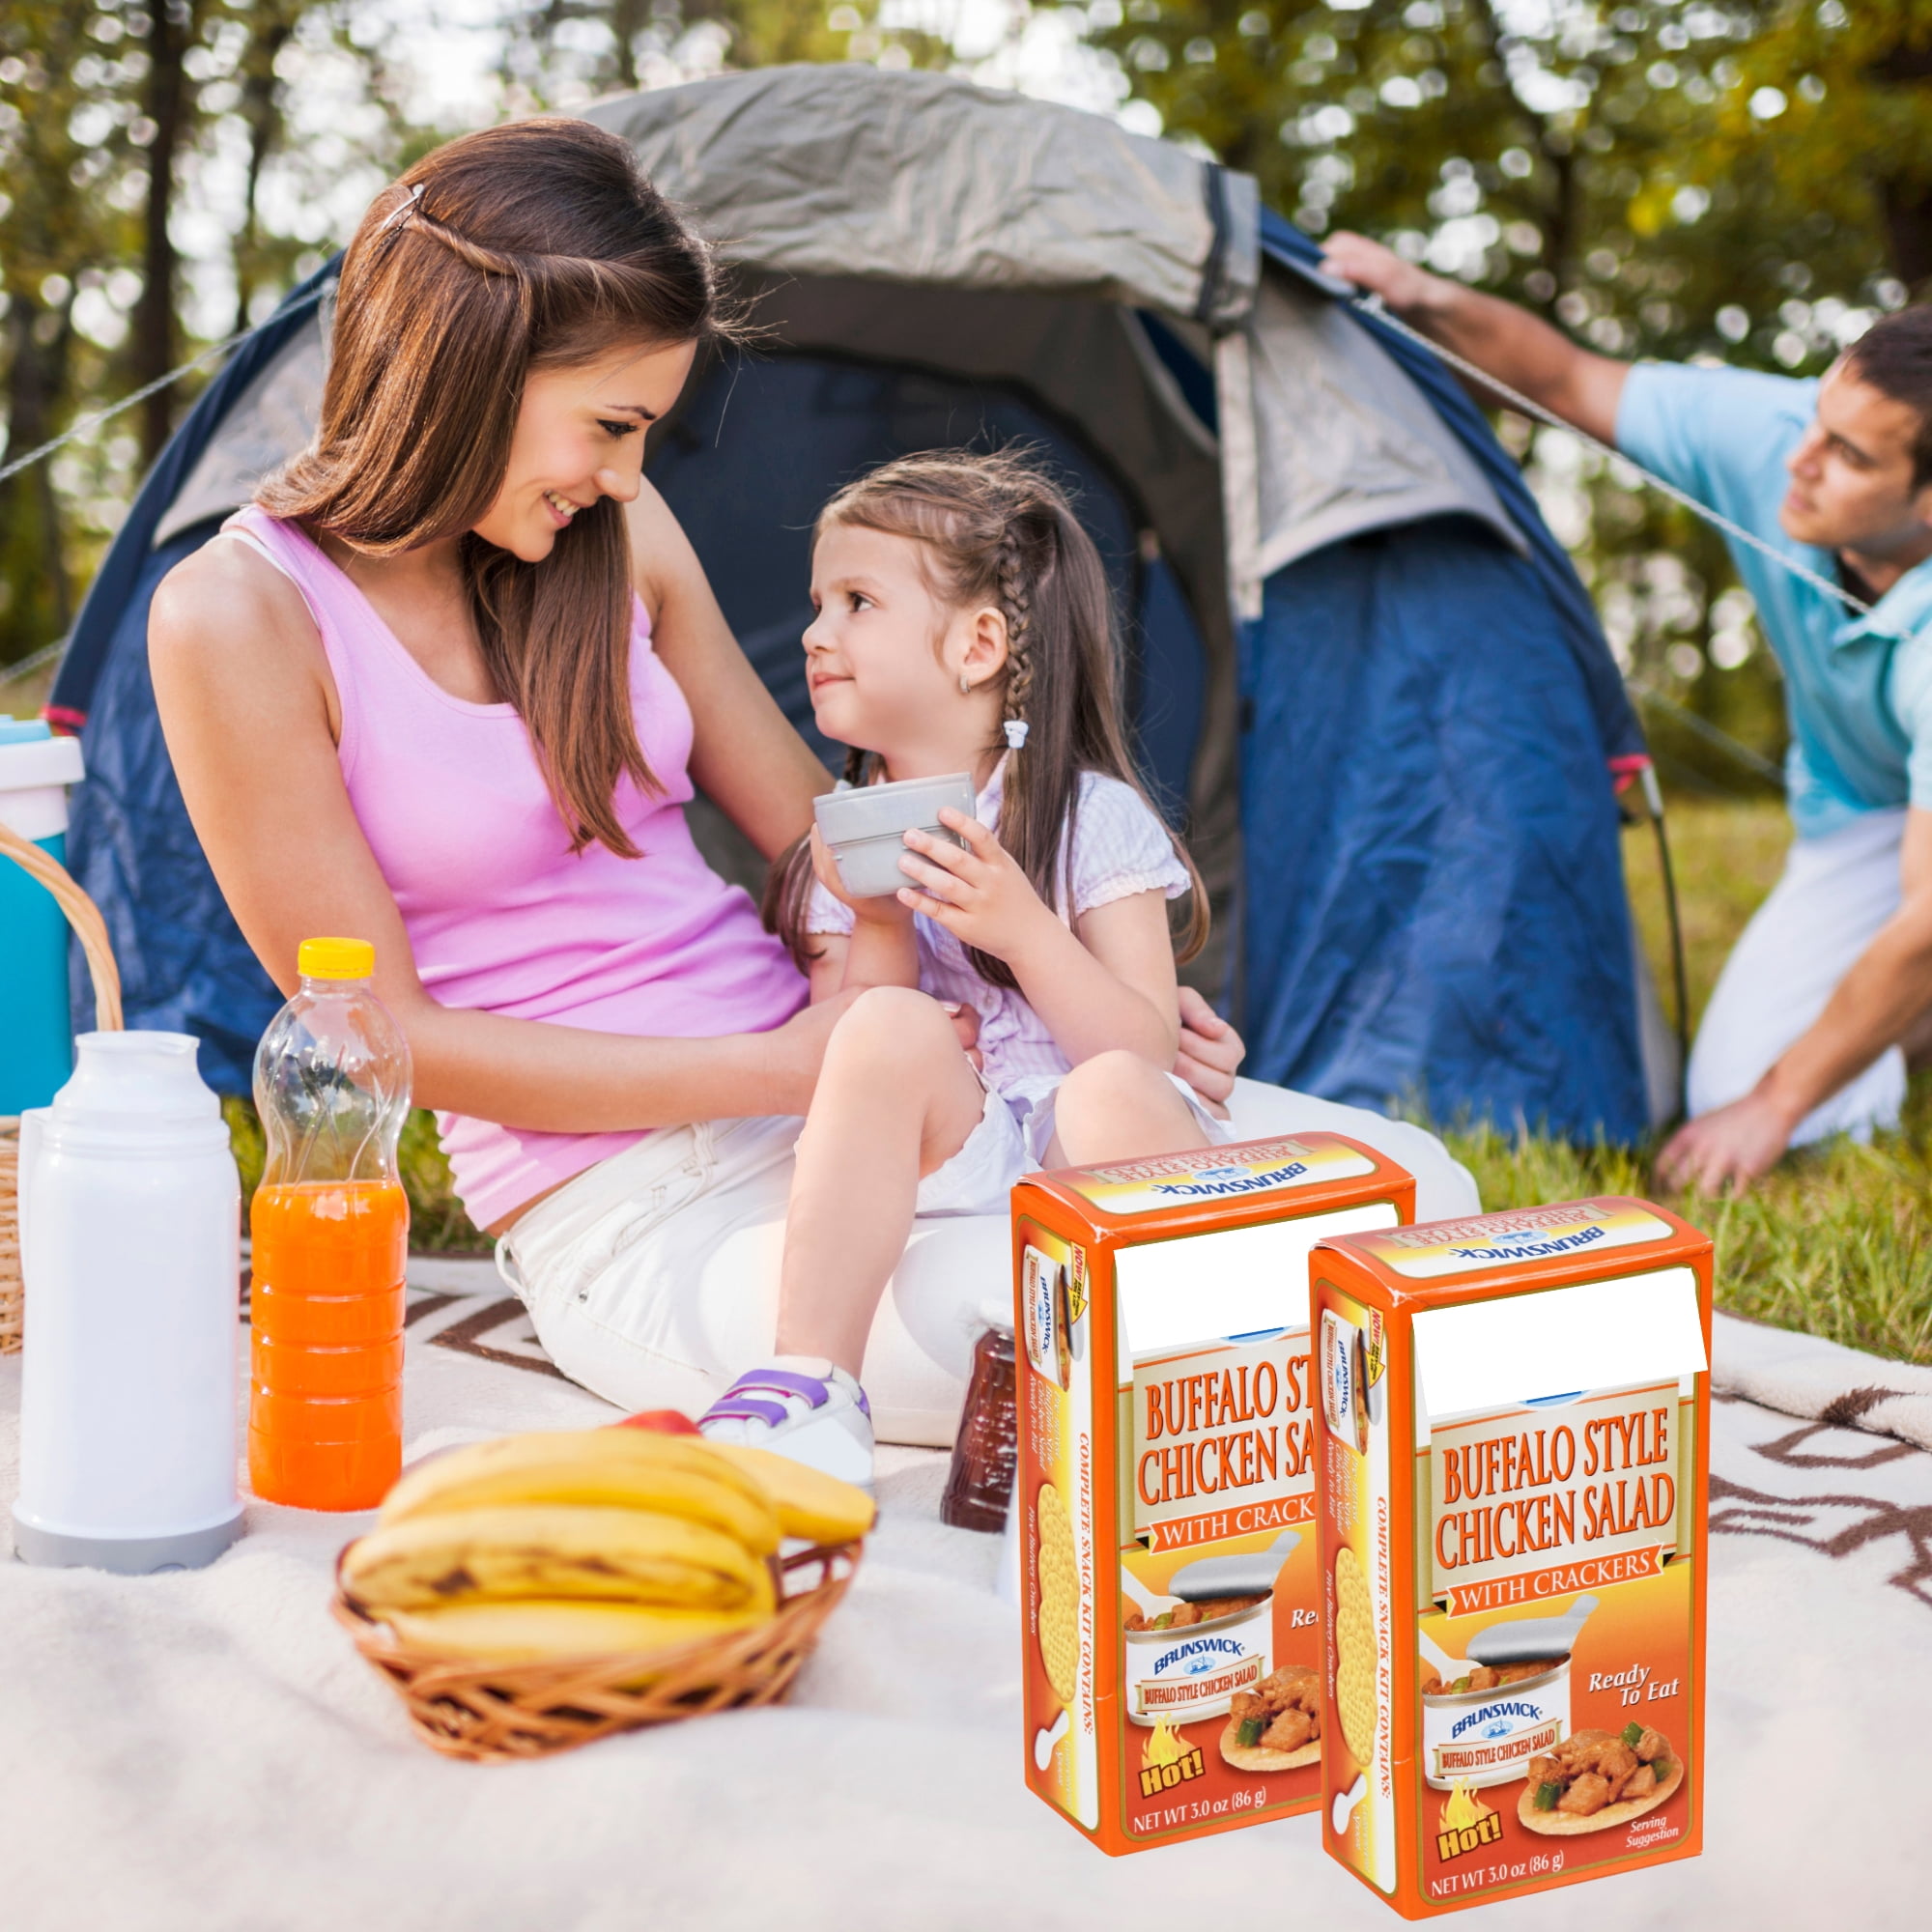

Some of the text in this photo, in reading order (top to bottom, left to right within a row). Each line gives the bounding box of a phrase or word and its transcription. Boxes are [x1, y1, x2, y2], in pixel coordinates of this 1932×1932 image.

[1159, 1162, 1308, 1195] BRUNSWICK
[1457, 1226, 1605, 1259] BRUNSWICK
[1040, 1276, 1051, 1351] BRUNSWICK
[1145, 1361, 1278, 1440] BUFFALO
[1338, 1340, 1349, 1415] BRUNSWICK
[1138, 1426, 1278, 1506] CHICKEN
[1442, 1407, 1668, 1504] BUFFALO STYLE
[1161, 1494, 1316, 1547] WITH CRACK
[1435, 1472, 1675, 1570] CHICKEN SALAD
[1080, 1433, 1094, 1735] COMPLETE SNACK KIT CONTAINS:
[1459, 1551, 1651, 1610] WITH CRACKERS
[1154, 1638, 1243, 1675] BRUNSWICK
[1378, 1496, 1391, 1799] COMPLETE SNACK KIT CONTAINS:
[1145, 1665, 1258, 1705] BUFFALO STYLE CHICKEN SALAD
[1588, 1663, 1651, 1692] Ready
[1620, 1678, 1680, 1707] To Eat
[1452, 1702, 1541, 1739] BRUNSWICK
[1139, 1747, 1206, 1799] Hot!
[1442, 1729, 1555, 1769] BUFFALO STYLE CHICKEN SALAD
[1134, 1785, 1267, 1833] NET WT 3.0 oz (86 g)
[1630, 1815, 1667, 1833] Serving
[1436, 1811, 1503, 1862] Hot!
[1626, 1827, 1679, 1848] Suggestion
[1432, 1849, 1565, 1896] NET WT 3.0 oz (86 g)
